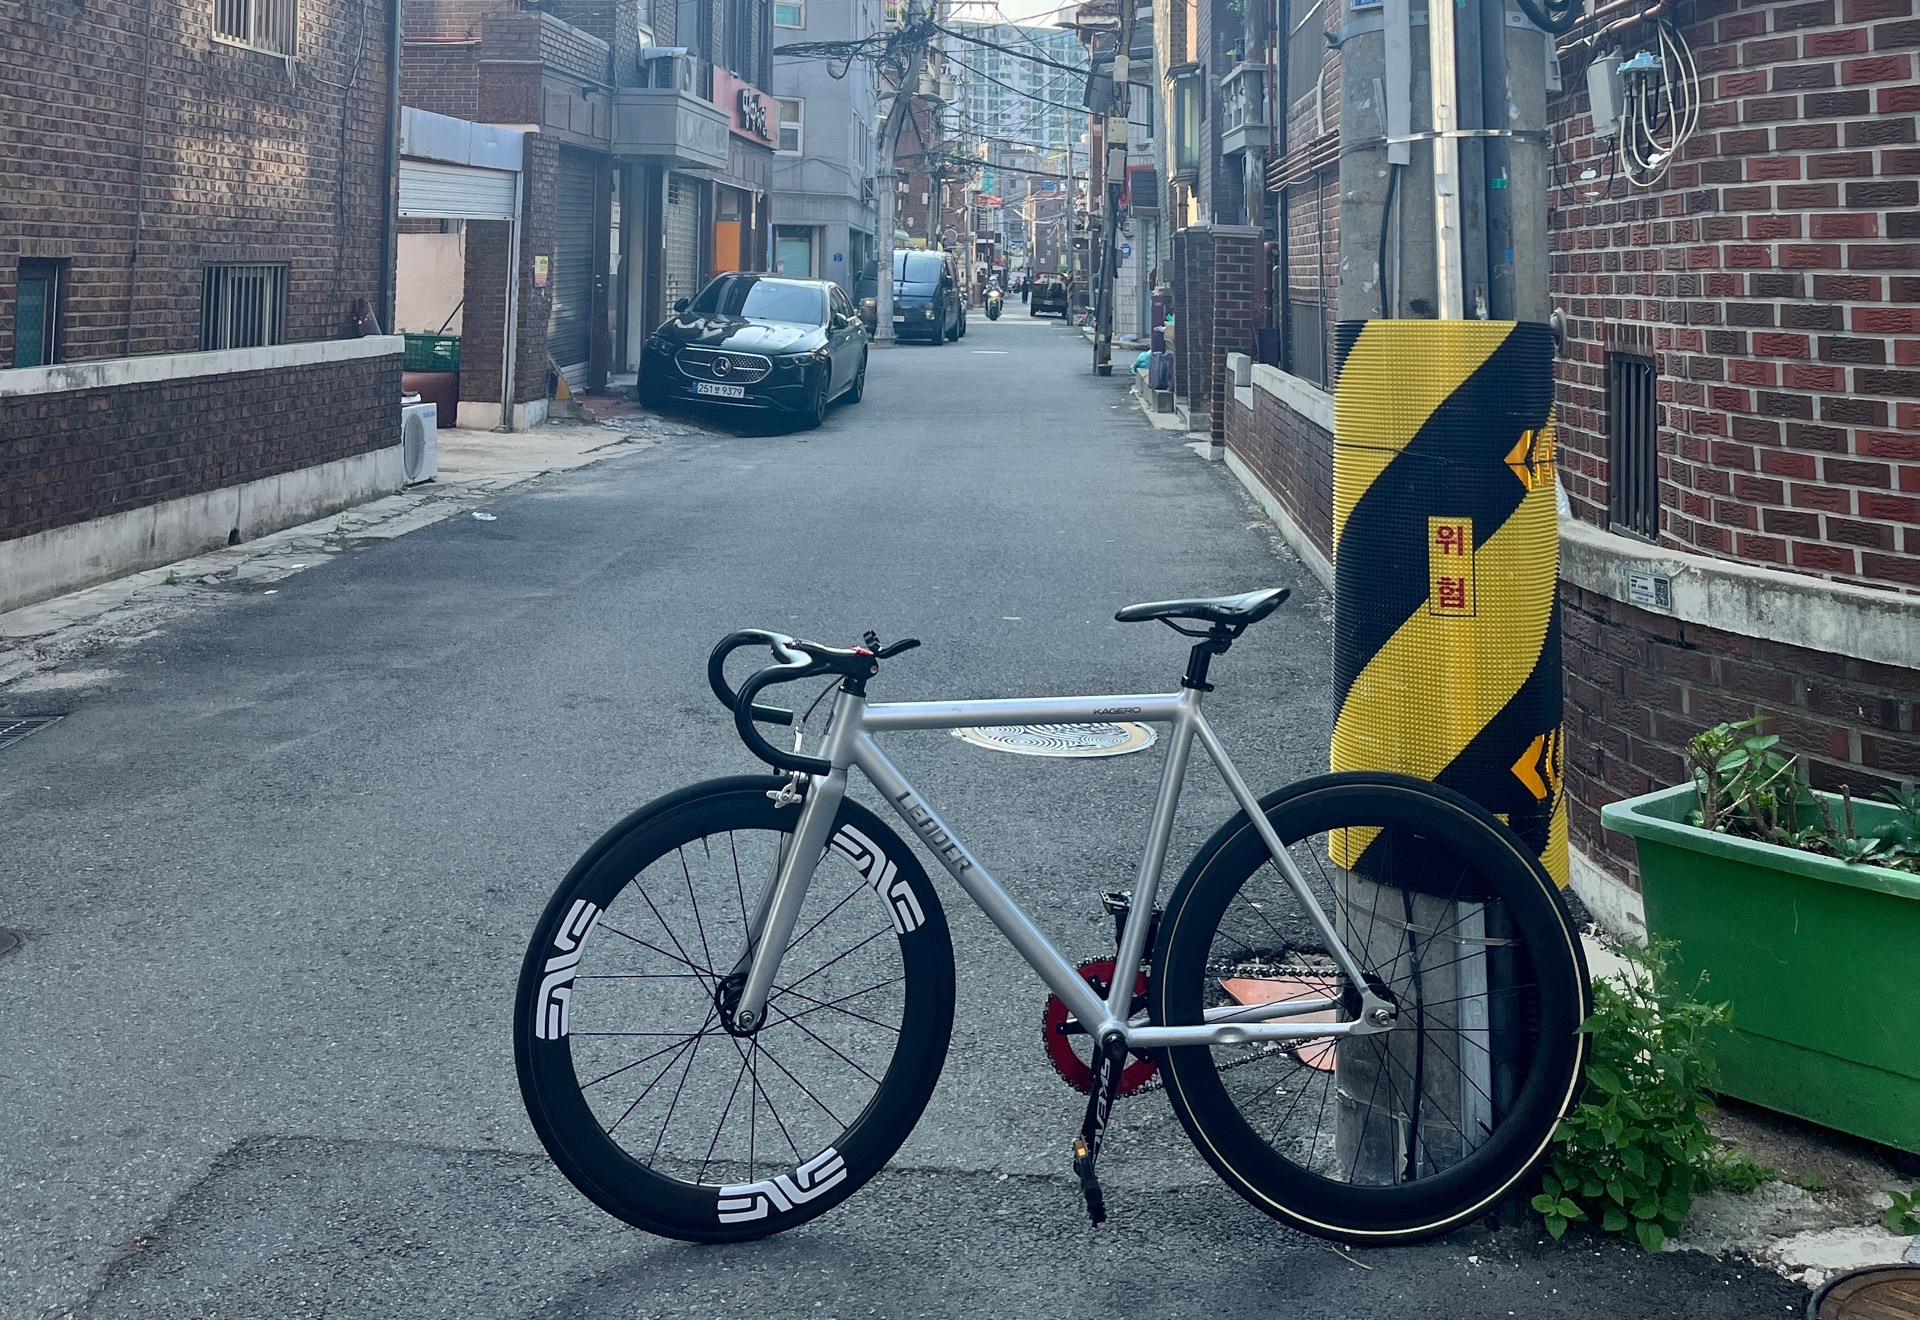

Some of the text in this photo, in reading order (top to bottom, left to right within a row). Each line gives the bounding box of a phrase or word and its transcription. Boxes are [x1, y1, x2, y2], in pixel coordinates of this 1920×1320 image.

[721, 386, 743, 396] 9379
[1435, 525, 1465, 608] 위험
[1093, 706, 1142, 715] KAGERO
[895, 790, 974, 877] LEADER
